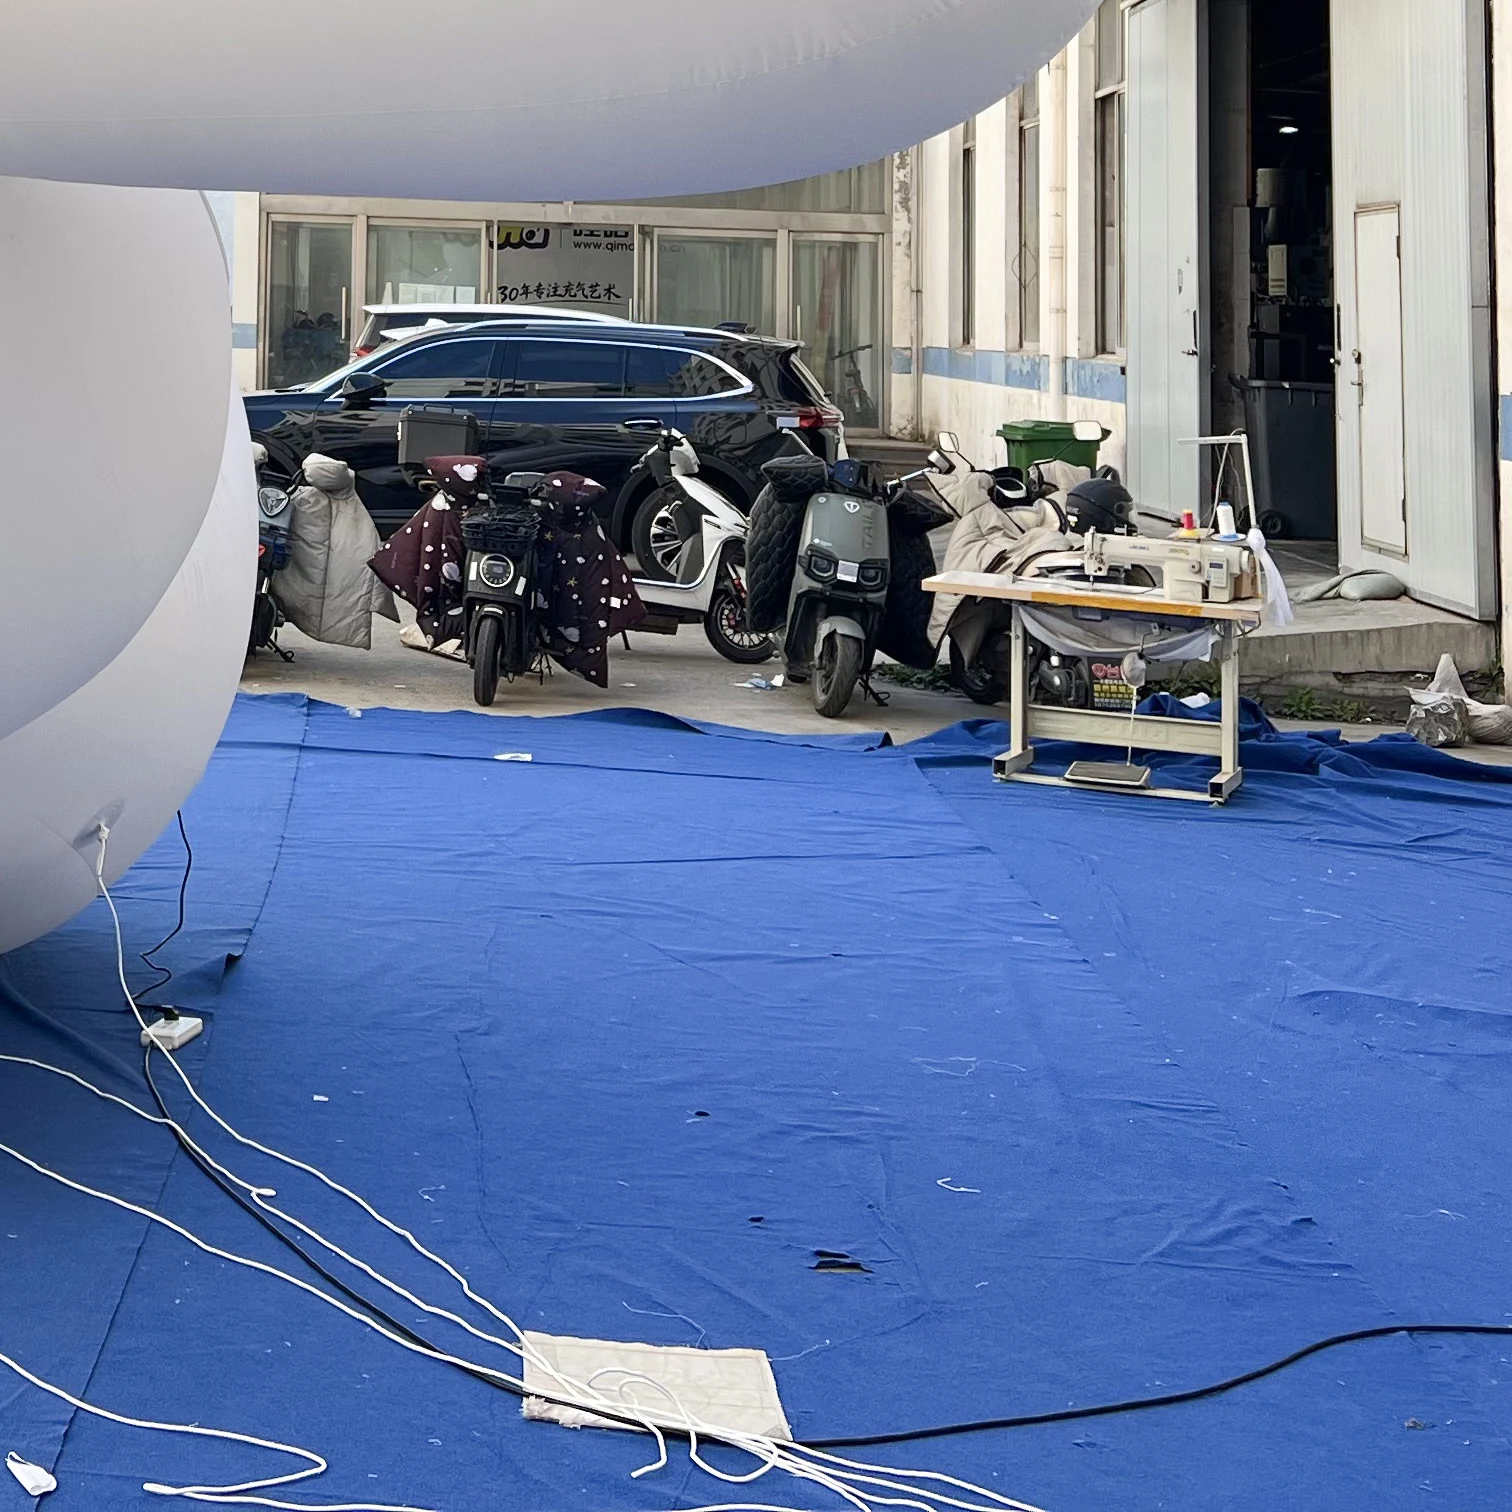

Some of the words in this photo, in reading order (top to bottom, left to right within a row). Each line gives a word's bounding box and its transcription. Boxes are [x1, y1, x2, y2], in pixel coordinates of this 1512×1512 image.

[497, 281, 622, 303] 30年专注充气艺术
